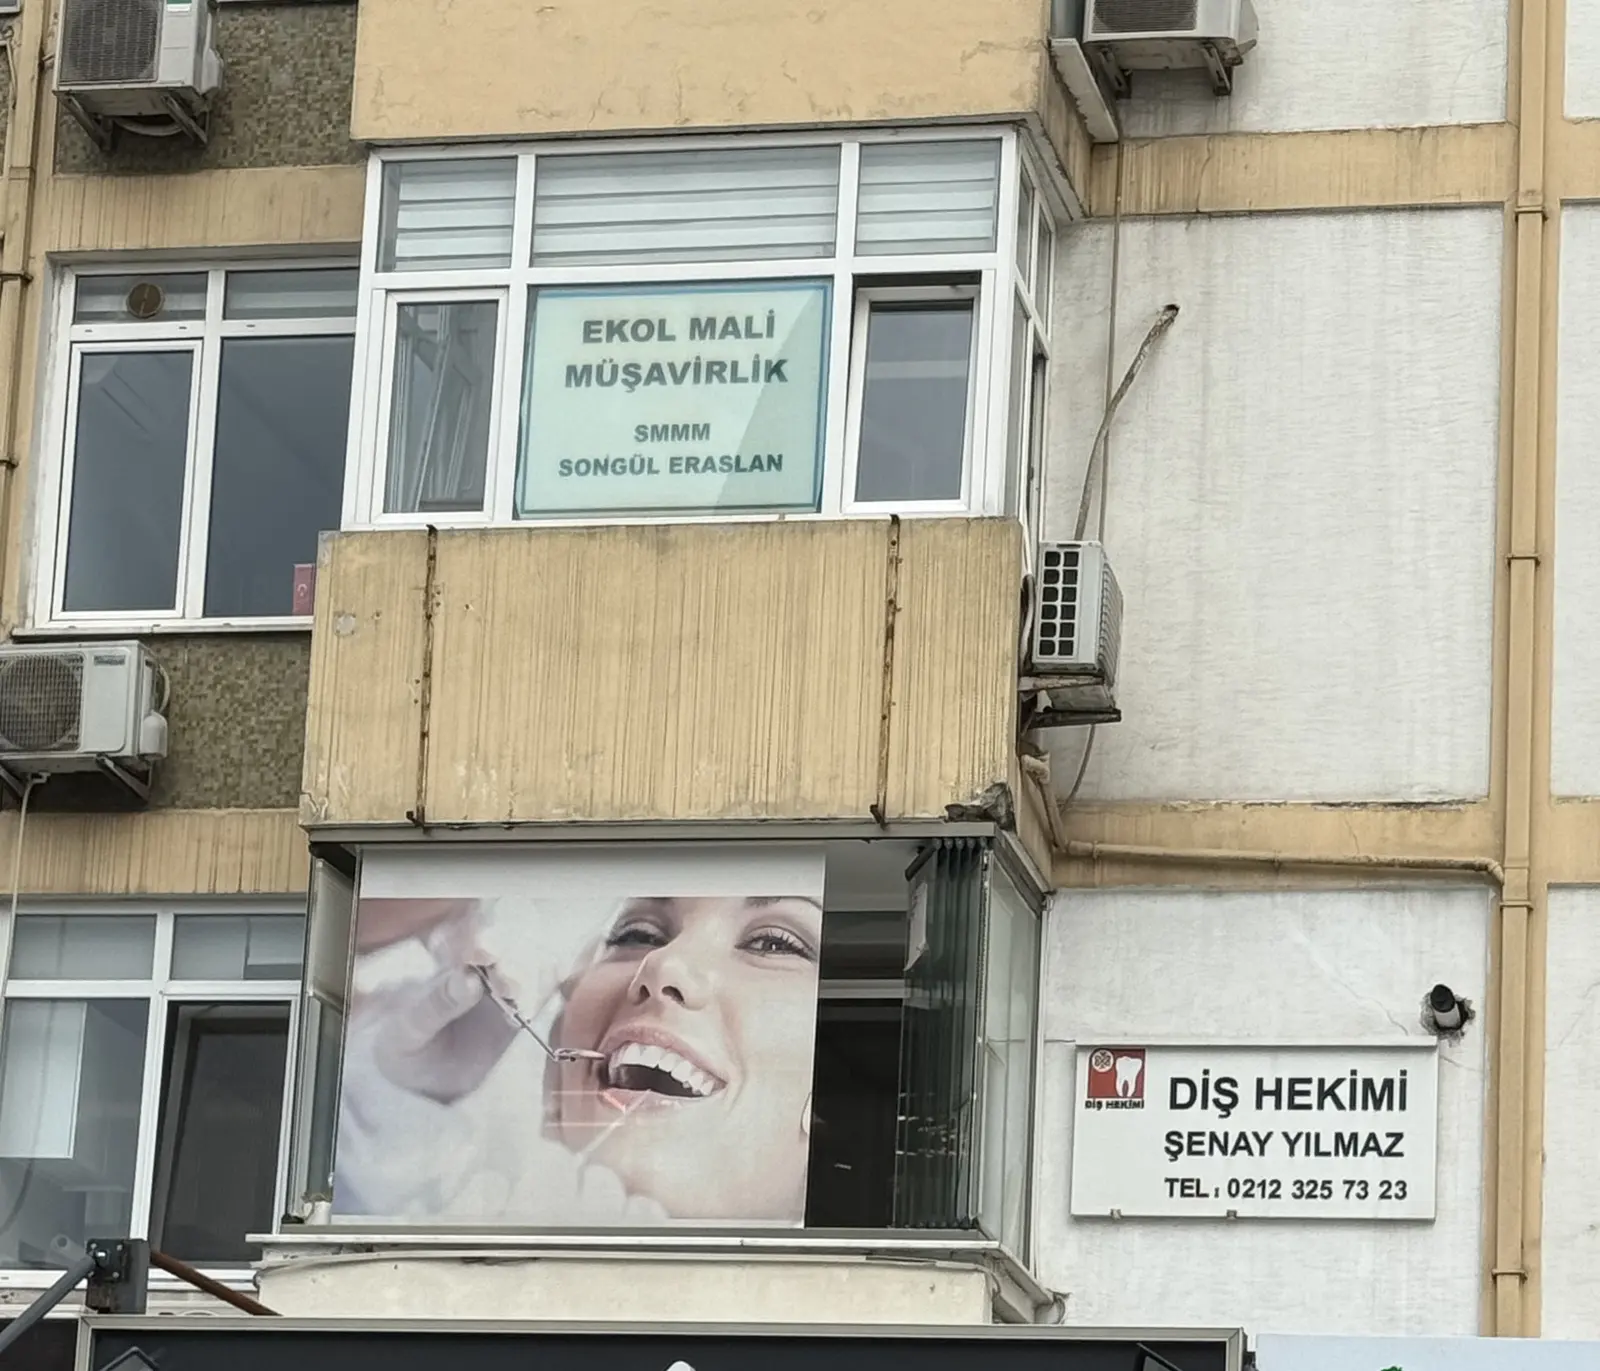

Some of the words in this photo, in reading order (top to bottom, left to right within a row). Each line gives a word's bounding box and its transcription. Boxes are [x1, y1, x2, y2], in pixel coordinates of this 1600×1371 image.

[582, 318, 676, 344] EKOL
[688, 309, 776, 341] MALİ
[565, 353, 789, 393] MÜŞAVİRLİK
[634, 423, 711, 442] SMMM
[558, 453, 660, 477] SONGÜL
[668, 453, 783, 475] ERASLAN
[1169, 1069, 1240, 1119] DİŞ
[1255, 1069, 1408, 1112] HEKİMİ
[1163, 1131, 1274, 1162] ŞENAY
[1281, 1132, 1405, 1158] YILMAZ
[1227, 1178, 1282, 1200] 0212
[1291, 1179, 1333, 1200] 325
[1342, 1180, 1370, 1200] 73
[1378, 1180, 1408, 1200] 23
